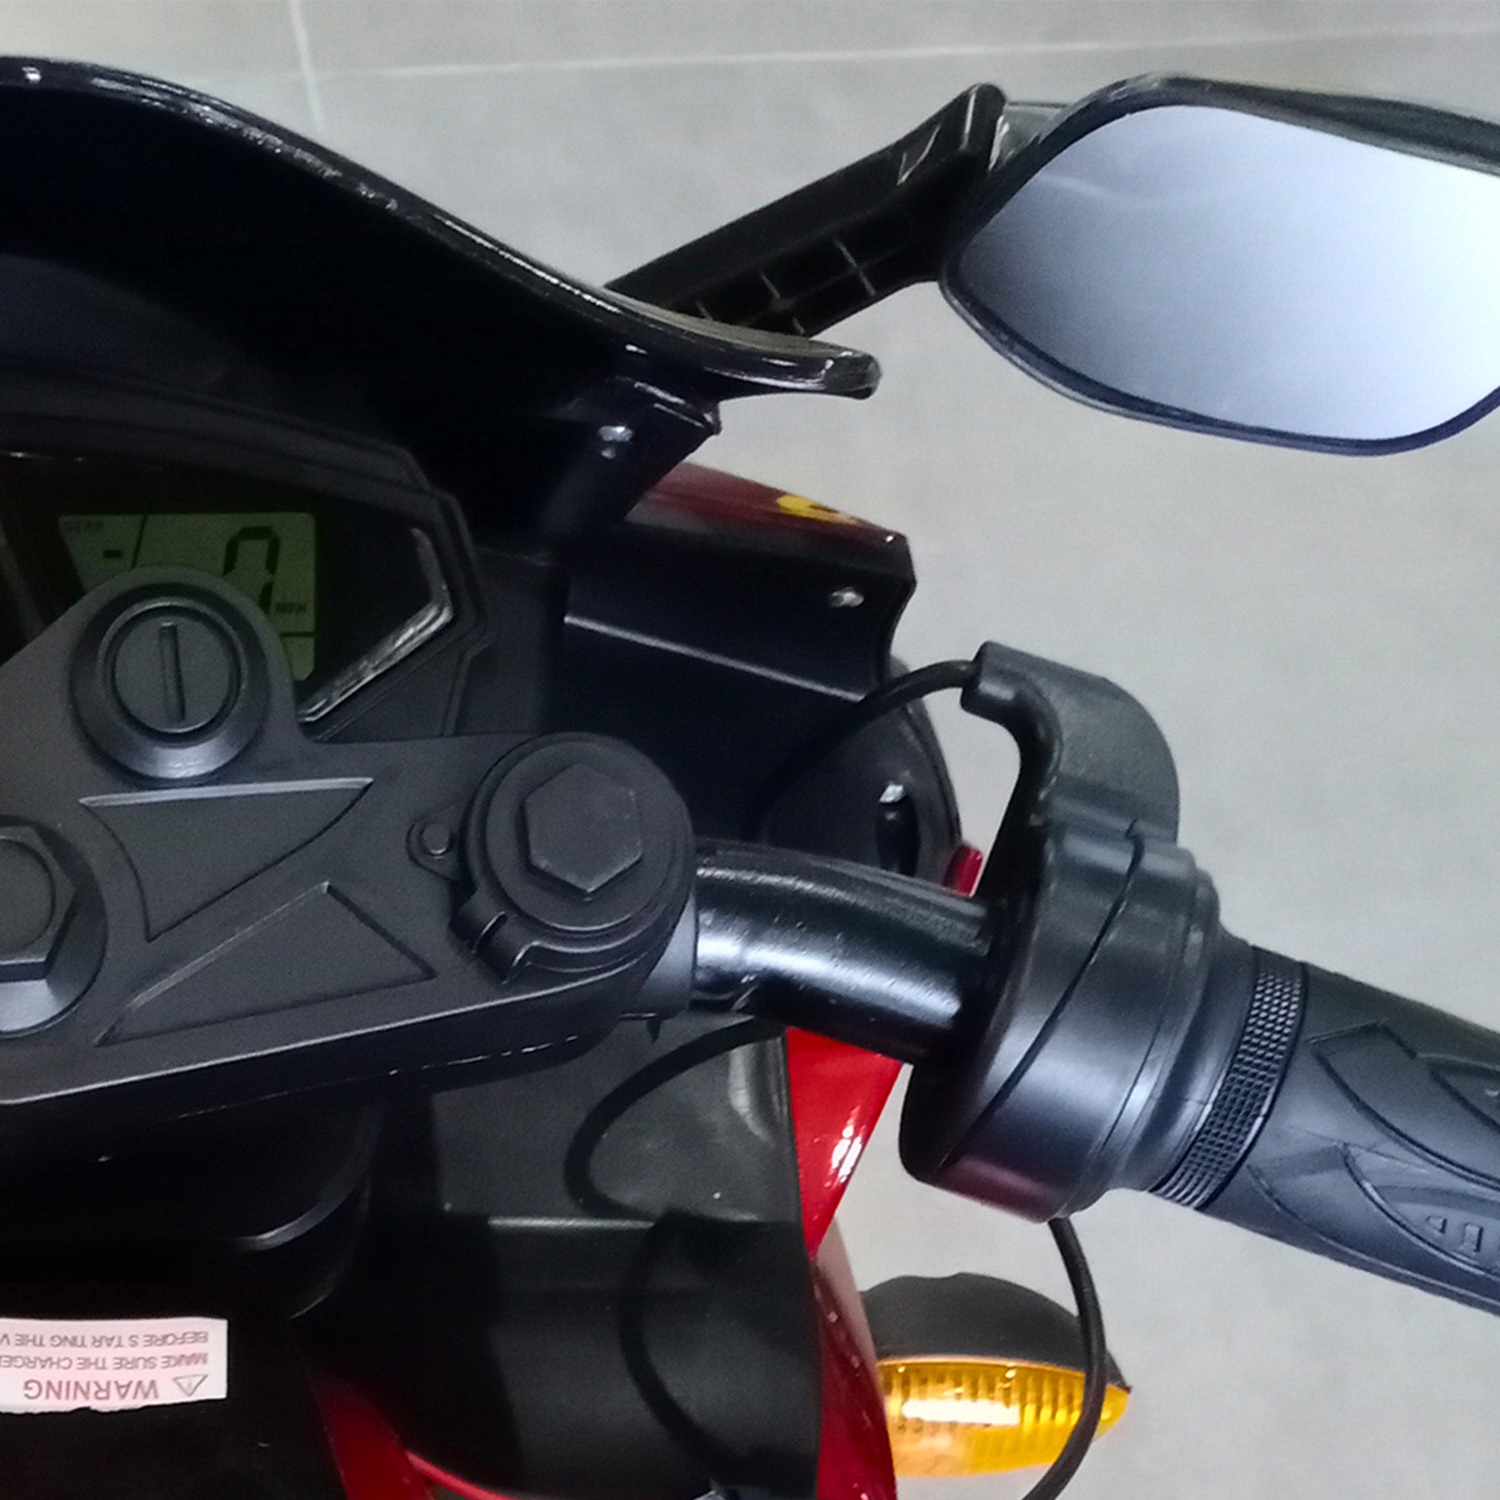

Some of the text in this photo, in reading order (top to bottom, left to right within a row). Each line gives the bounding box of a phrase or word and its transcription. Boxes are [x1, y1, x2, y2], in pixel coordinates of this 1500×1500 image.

[15, 1333, 45, 1347] THE
[142, 1331, 209, 1348] BEFORE
[76, 1357, 110, 1370] THE
[113, 1355, 157, 1370] SURE
[161, 1352, 209, 1368] MAKE
[24, 1379, 159, 1401] WARNING
